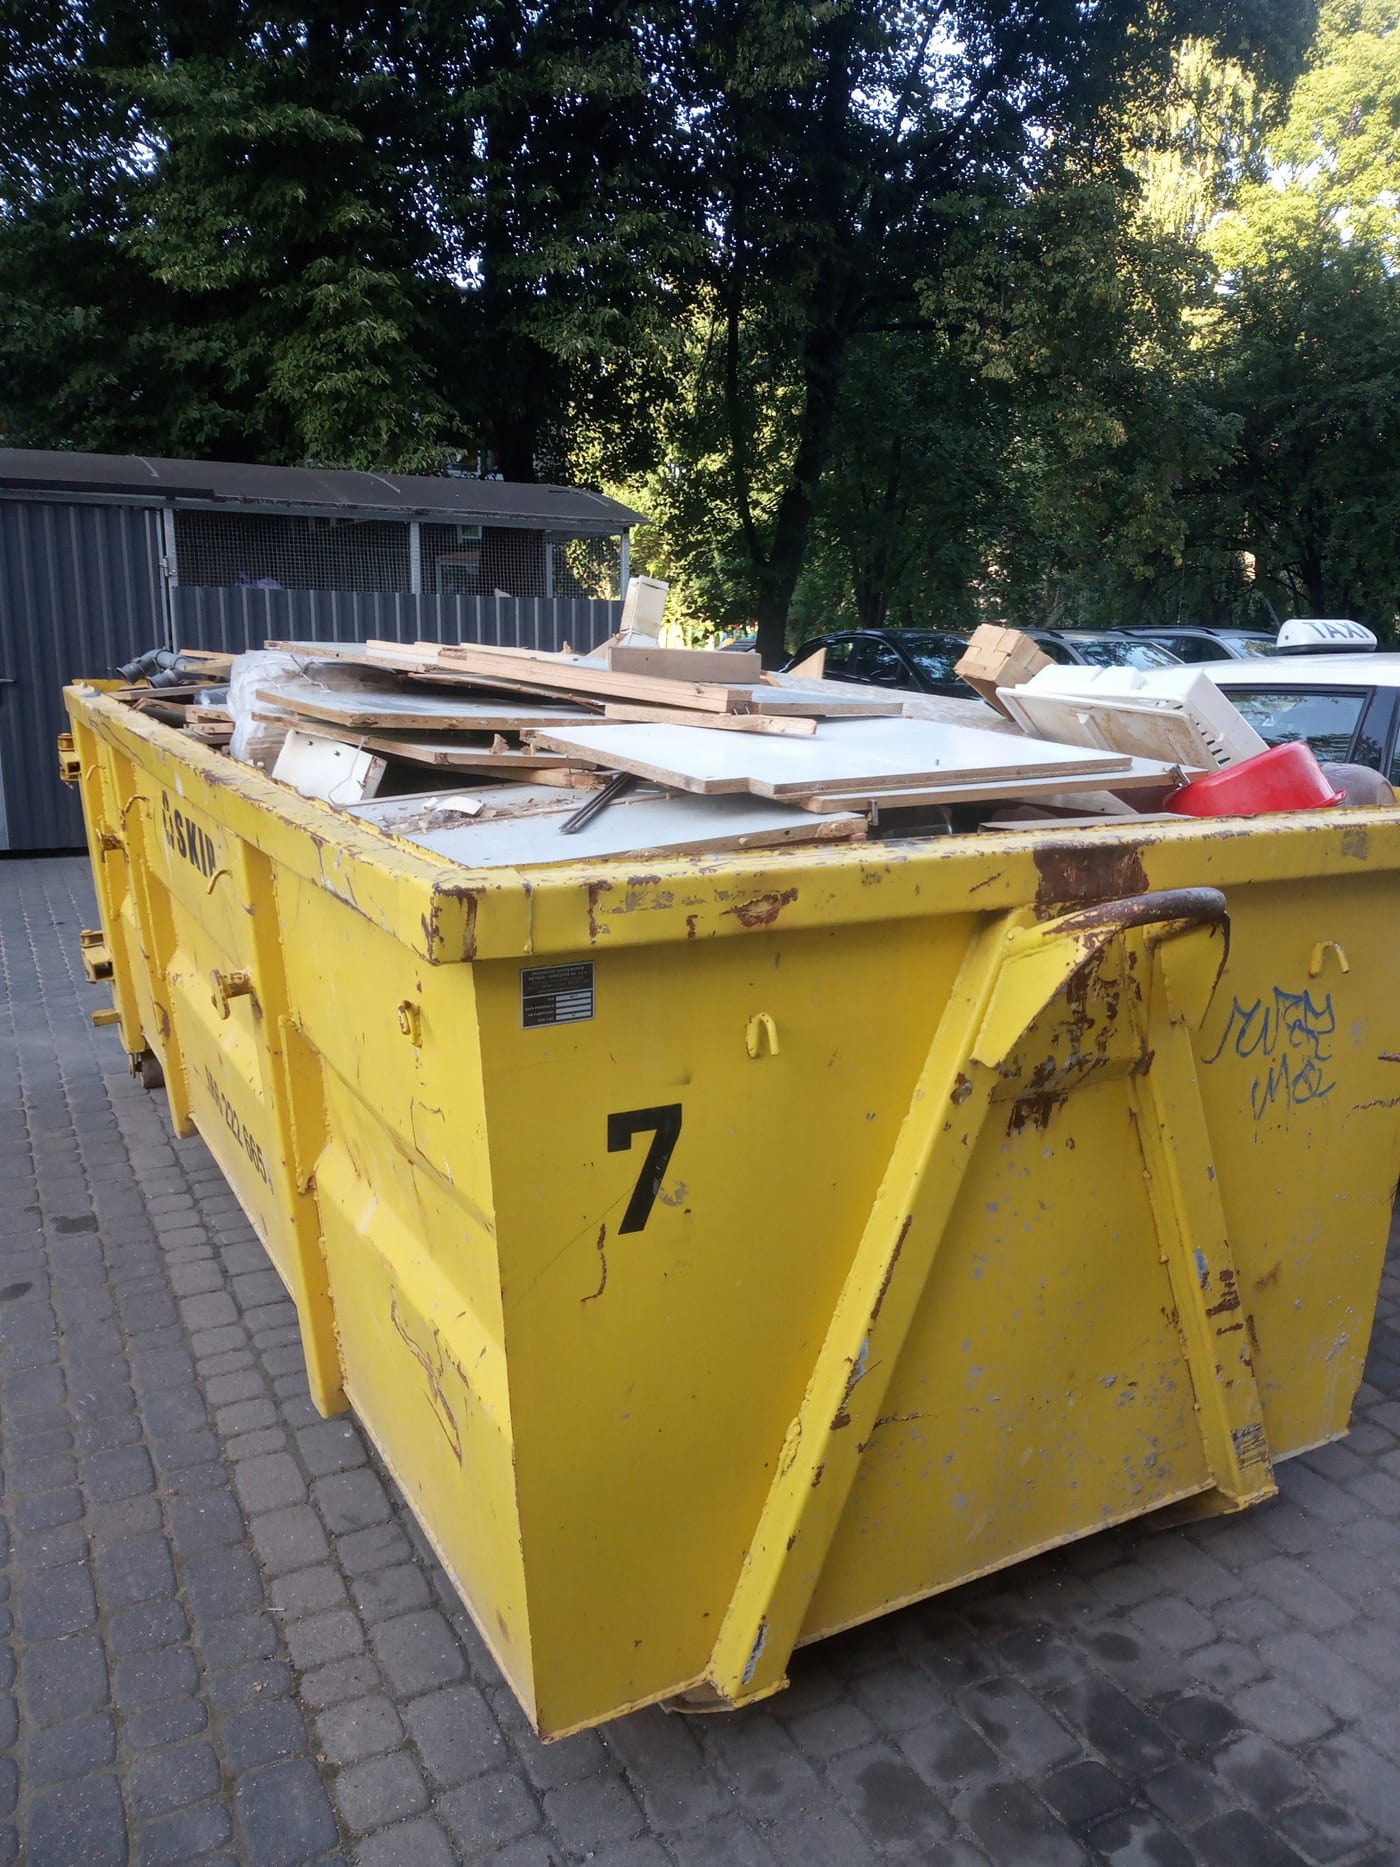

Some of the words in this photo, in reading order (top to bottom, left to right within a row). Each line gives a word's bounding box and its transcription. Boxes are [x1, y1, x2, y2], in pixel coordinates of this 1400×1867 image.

[1302, 622, 1370, 639] TAXI
[174, 808, 217, 878] SKIP
[607, 1103, 682, 1235] 7
